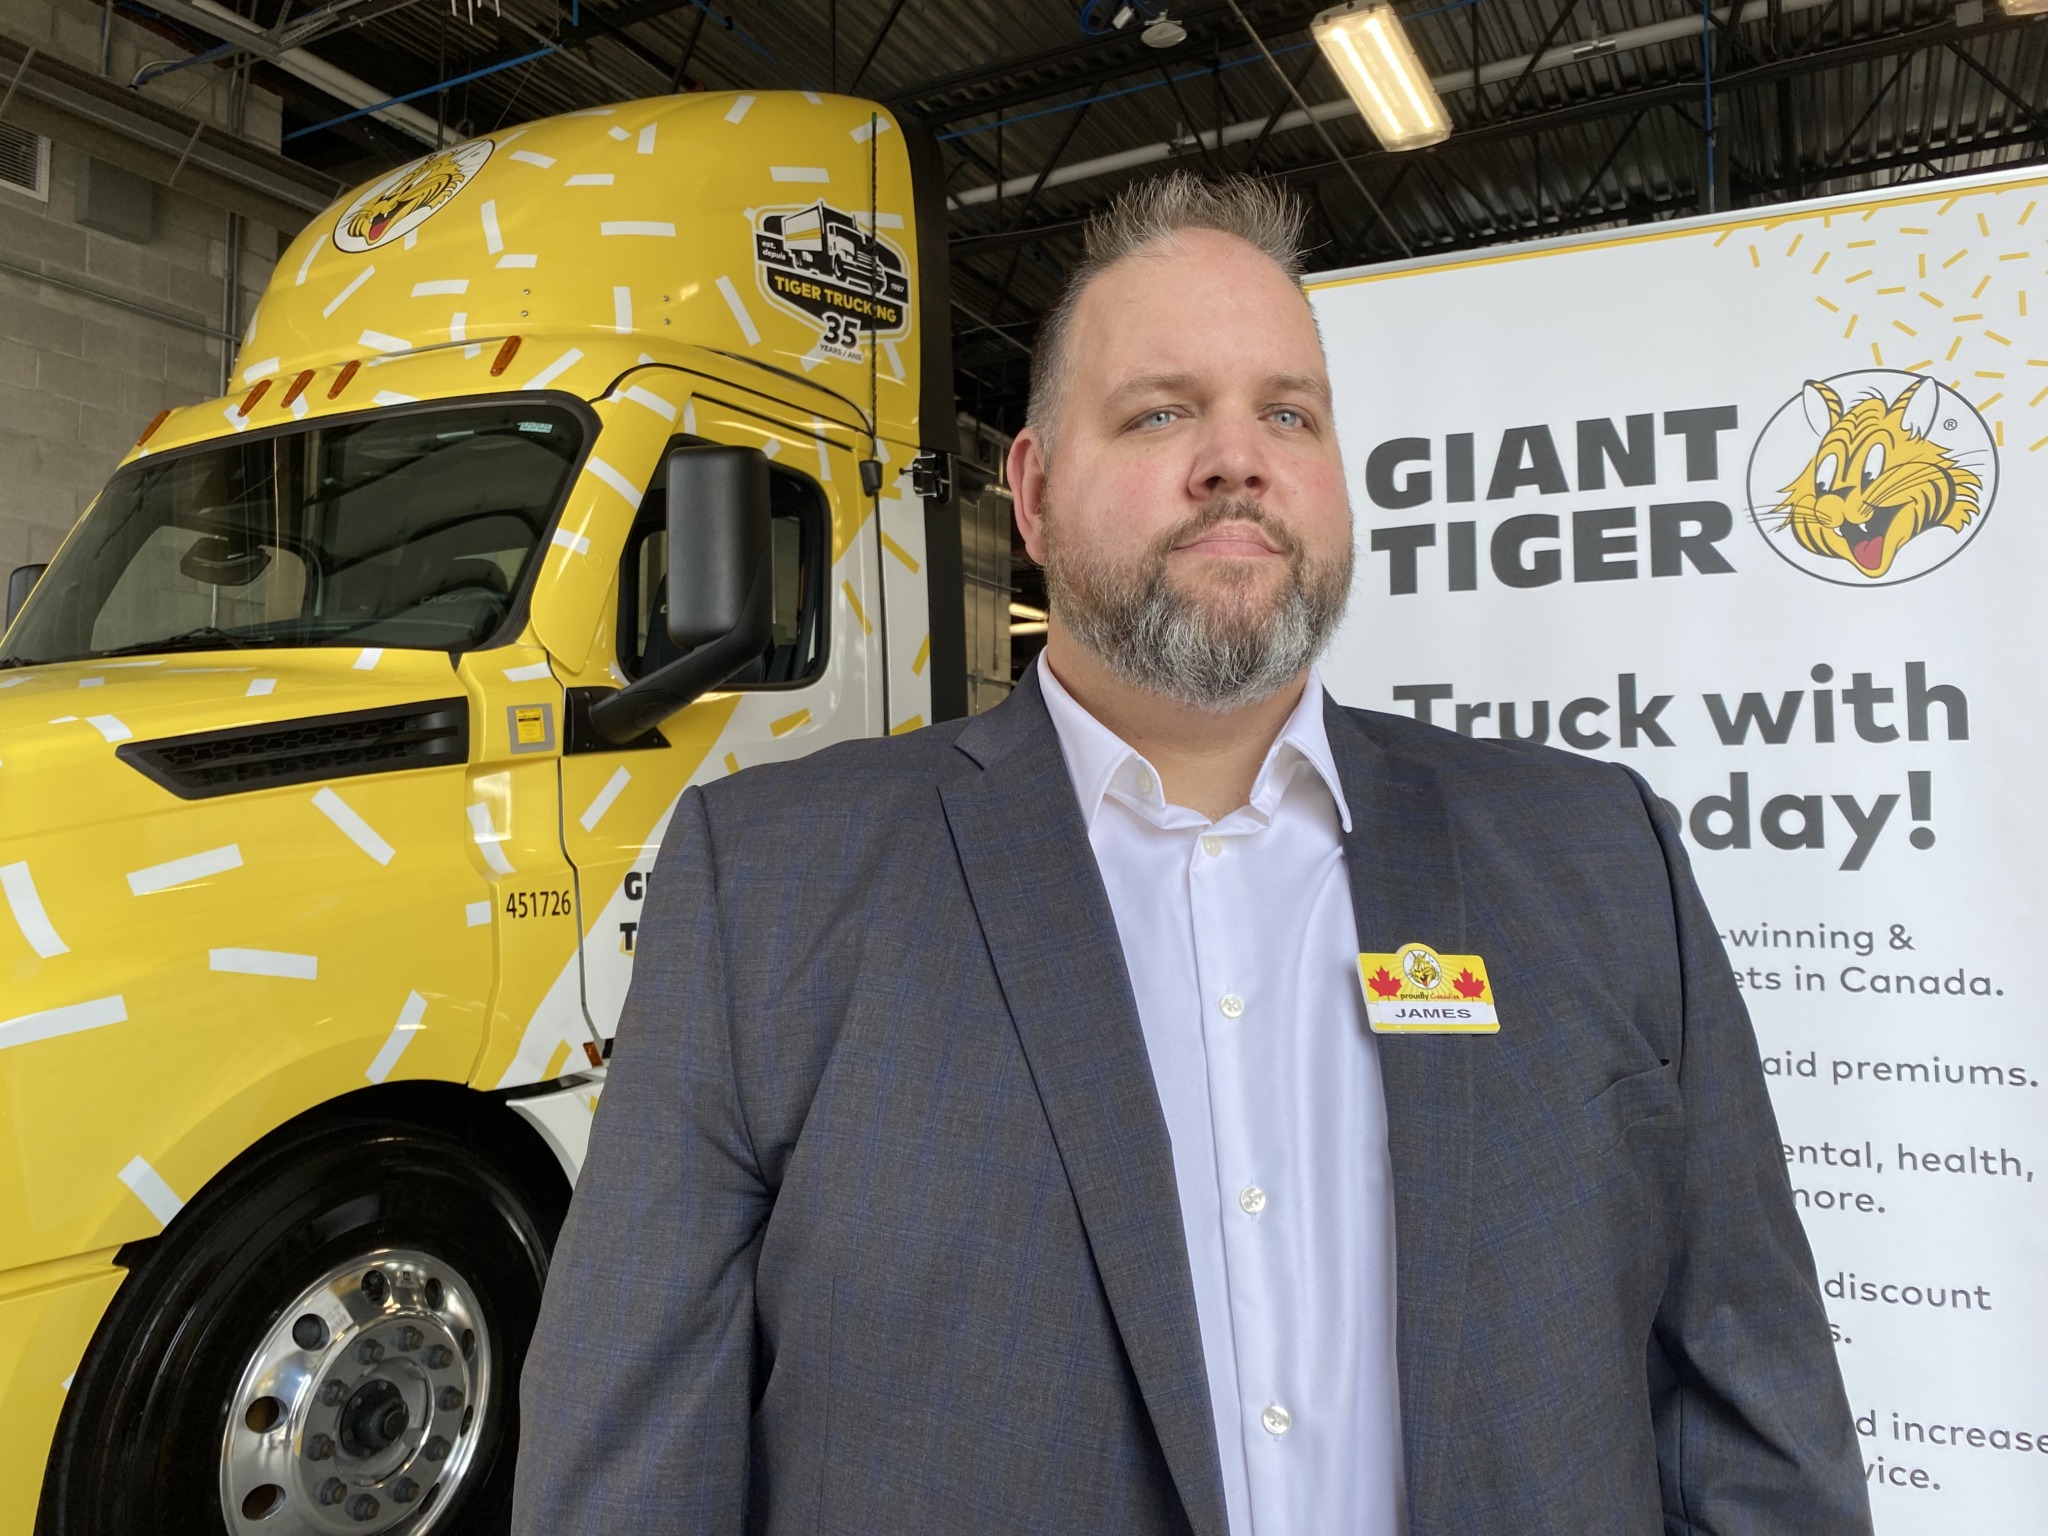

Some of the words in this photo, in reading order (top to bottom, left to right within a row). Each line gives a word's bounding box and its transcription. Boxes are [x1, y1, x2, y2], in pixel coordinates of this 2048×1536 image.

[774, 275, 822, 301] TIGER
[824, 288, 897, 323] TRUCKNG
[823, 315, 860, 350] 35
[820, 343, 843, 357] YEARS
[848, 351, 862, 362] ANS
[1365, 404, 1738, 510] GIANT
[1371, 500, 1738, 596] TIGER
[1393, 673, 1677, 751] Truck
[1702, 661, 1969, 746] with
[1659, 770, 1937, 871] day!
[506, 889, 572, 919] 451726
[1889, 923, 1916, 951] &
[1400, 992, 1429, 1001] proudly
[1795, 965, 1826, 992] in
[1840, 966, 2006, 997] Canada.
[1395, 1008, 1472, 1019] JAMES
[1762, 1050, 1817, 1078] aid
[1832, 1056, 2040, 1088] premiums.
[1898, 1143, 2035, 1183] health,
[1824, 1272, 1993, 1311] discount
[1892, 1412, 2048, 1455] increase
